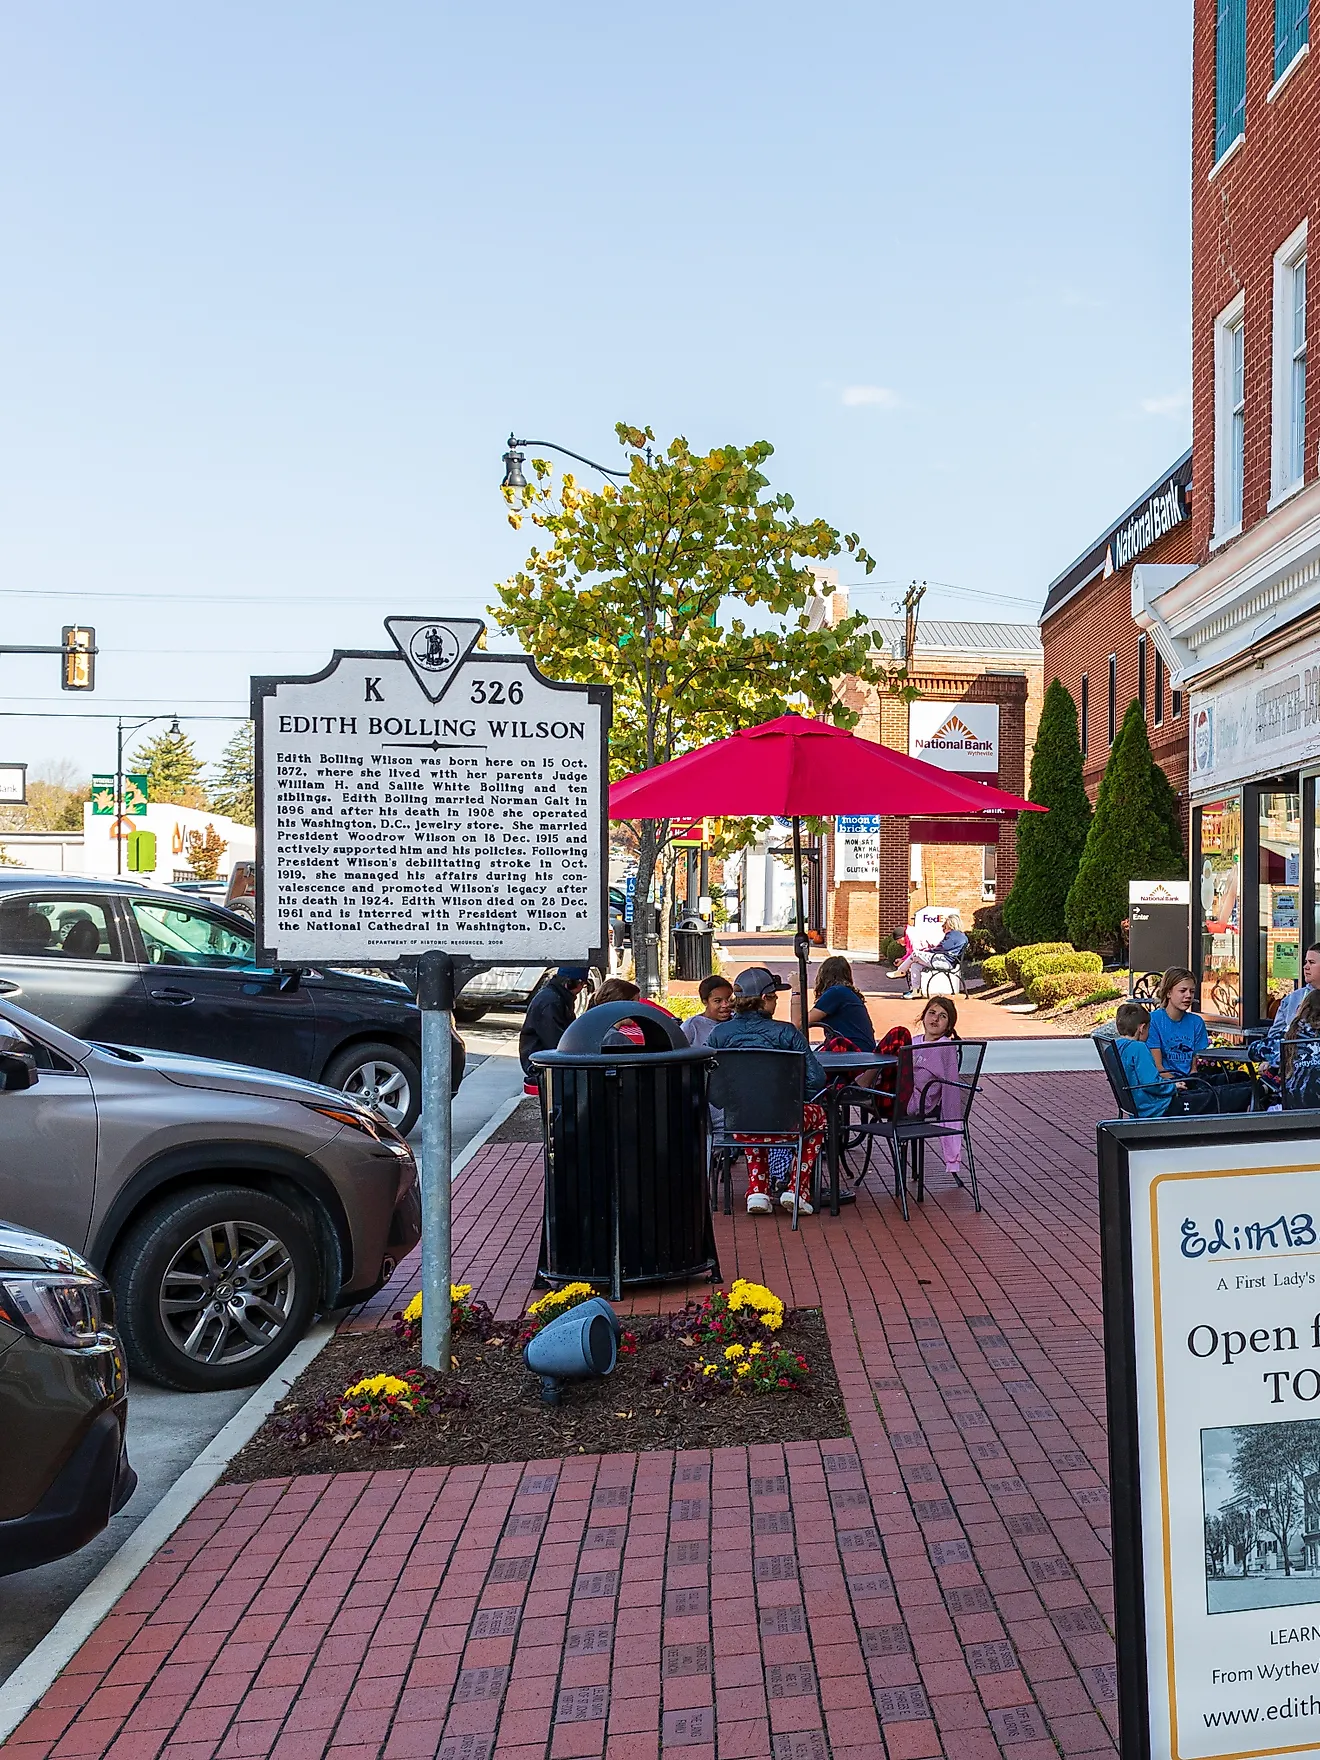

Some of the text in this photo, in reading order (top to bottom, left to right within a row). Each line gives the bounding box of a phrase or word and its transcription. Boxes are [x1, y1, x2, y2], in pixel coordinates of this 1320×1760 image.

[1115, 479, 1183, 571] National Bank
[364, 677, 525, 705] K 326
[278, 715, 586, 741] EDITH BOLLING WILSON
[915, 738, 994, 751] National Bank
[276, 752, 311, 763] Edith
[319, 753, 363, 766] Bolling
[370, 754, 412, 766] Wilson
[448, 756, 478, 766] born
[485, 756, 513, 767] here
[520, 759, 535, 767] on
[542, 757, 554, 767] 15
[561, 758, 587, 768] Oct.
[276, 766, 587, 782] 1872, where she lived with her parents Judge
[276, 778, 587, 794] William H. and Sallie White Bolling and ten
[277, 791, 587, 806] siblings. Edith Bolling married Norman Galt in
[277, 805, 587, 820] 1896 and after his death in 1908 she operated
[842, 816, 870, 825] moon
[277, 817, 587, 831] his Washington, D.C., jewelry store. She married
[277, 830, 338, 841] President
[347, 831, 405, 841] Woodrow
[414, 832, 455, 842] Wilson
[484, 833, 495, 842] 18
[502, 833, 530, 843] Dec.
[536, 833, 558, 843] 1915
[565, 833, 587, 843] and
[277, 843, 587, 858] actively supported him and his policies. Following
[277, 856, 587, 869] President Wilson's debilitating stroke in Oct.
[923, 914, 947, 923] FedE
[1180, 1214, 1284, 1259] Edith
[1216, 1277, 1229, 1291] A
[1235, 1274, 1267, 1290] First
[1273, 1271, 1316, 1291] Lady's
[1187, 1324, 1298, 1365] Open
[1212, 1666, 1253, 1685] From
